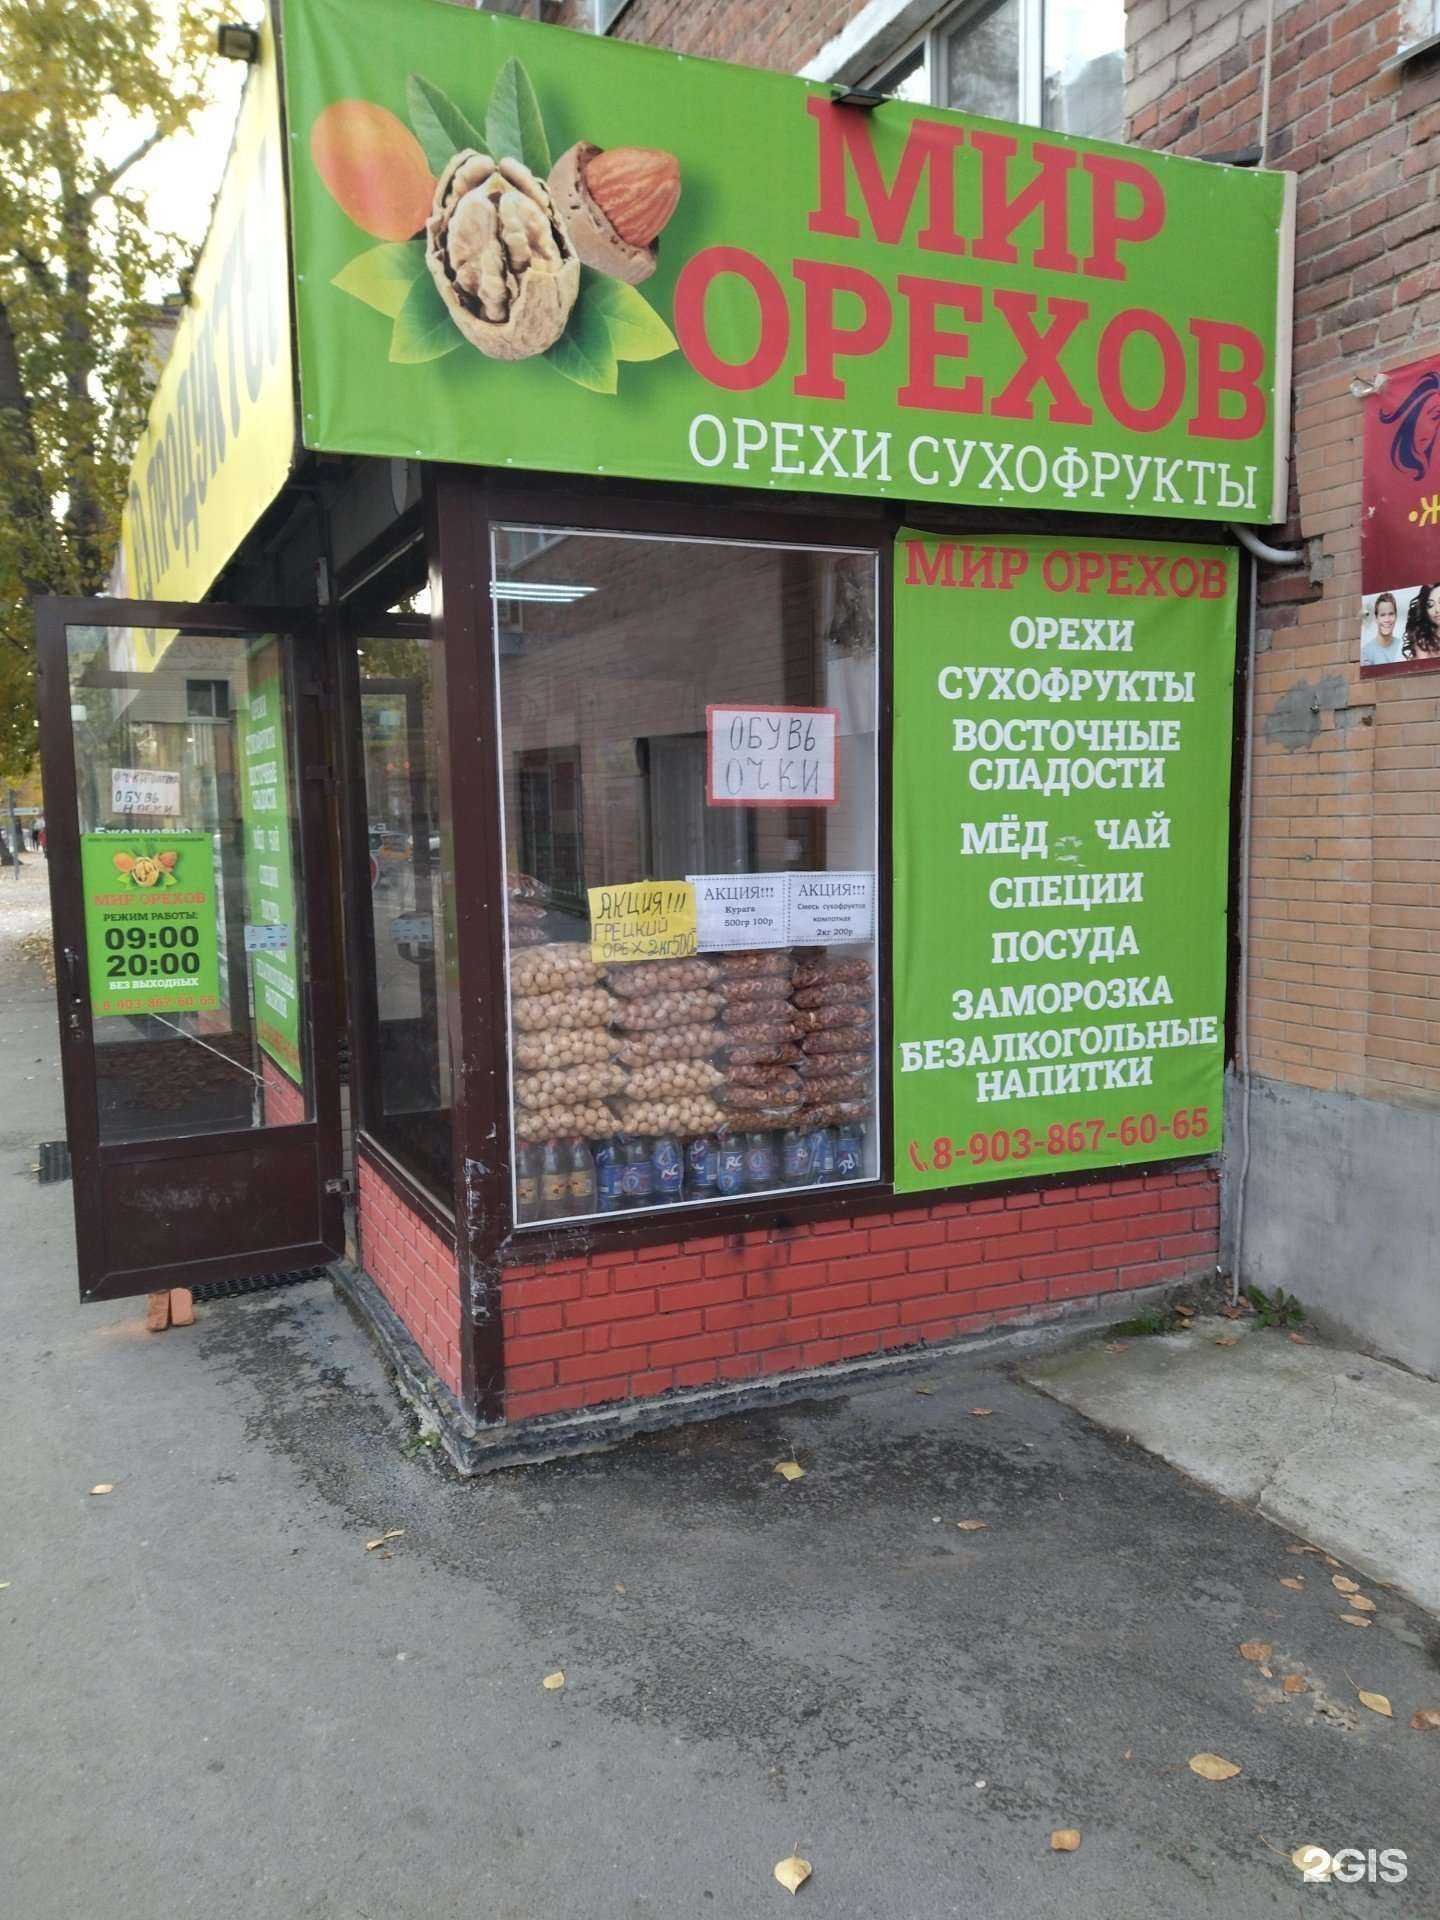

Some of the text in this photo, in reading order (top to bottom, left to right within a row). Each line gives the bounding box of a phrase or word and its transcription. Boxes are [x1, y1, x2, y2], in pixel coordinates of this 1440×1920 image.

[807, 96, 1166, 282] МИР
[673, 245, 1267, 441] ОРЕХОВ
[688, 414, 1258, 510] ОРЕХИ СУХОФРУКТЫ
[905, 540, 1228, 599] МИР ОРЕХОВ
[1009, 616, 1135, 651] ОРЕХИ
[937, 666, 1196, 702] СУХОФРУКТЫ
[729, 716, 817, 751] ОБУВЬ
[953, 719, 1181, 751] ВОСТОЧНЫЕ
[726, 758, 819, 795] ОЧКИ
[969, 757, 1166, 797] СЛАДОСТИ
[960, 810, 1171, 859] МЁД ЧАЙ
[597, 890, 687, 919] АКЦИЯ!!!
[703, 886, 774, 901] АКЦИЯ!!!
[798, 883, 865, 897] АКЦИЯ!!!
[989, 872, 1144, 911] СПЕЦИИ
[103, 911, 198, 922] РЕЖИМ РАБОТЫ:
[593, 917, 669, 942] ГРЕЦКИЙ
[105, 925, 199, 950] 09:00
[992, 925, 1140, 964] ПОСУДА
[106, 952, 200, 977] 20:00
[952, 975, 1174, 1021] ЗАМОРОЗКА
[898, 1016, 1219, 1072] БЕЗАЛКОГОЛЬНЫЕ
[976, 1056, 1153, 1102] НАПИТКИ
[932, 1107, 1210, 1170] 8-903-867-60-65
